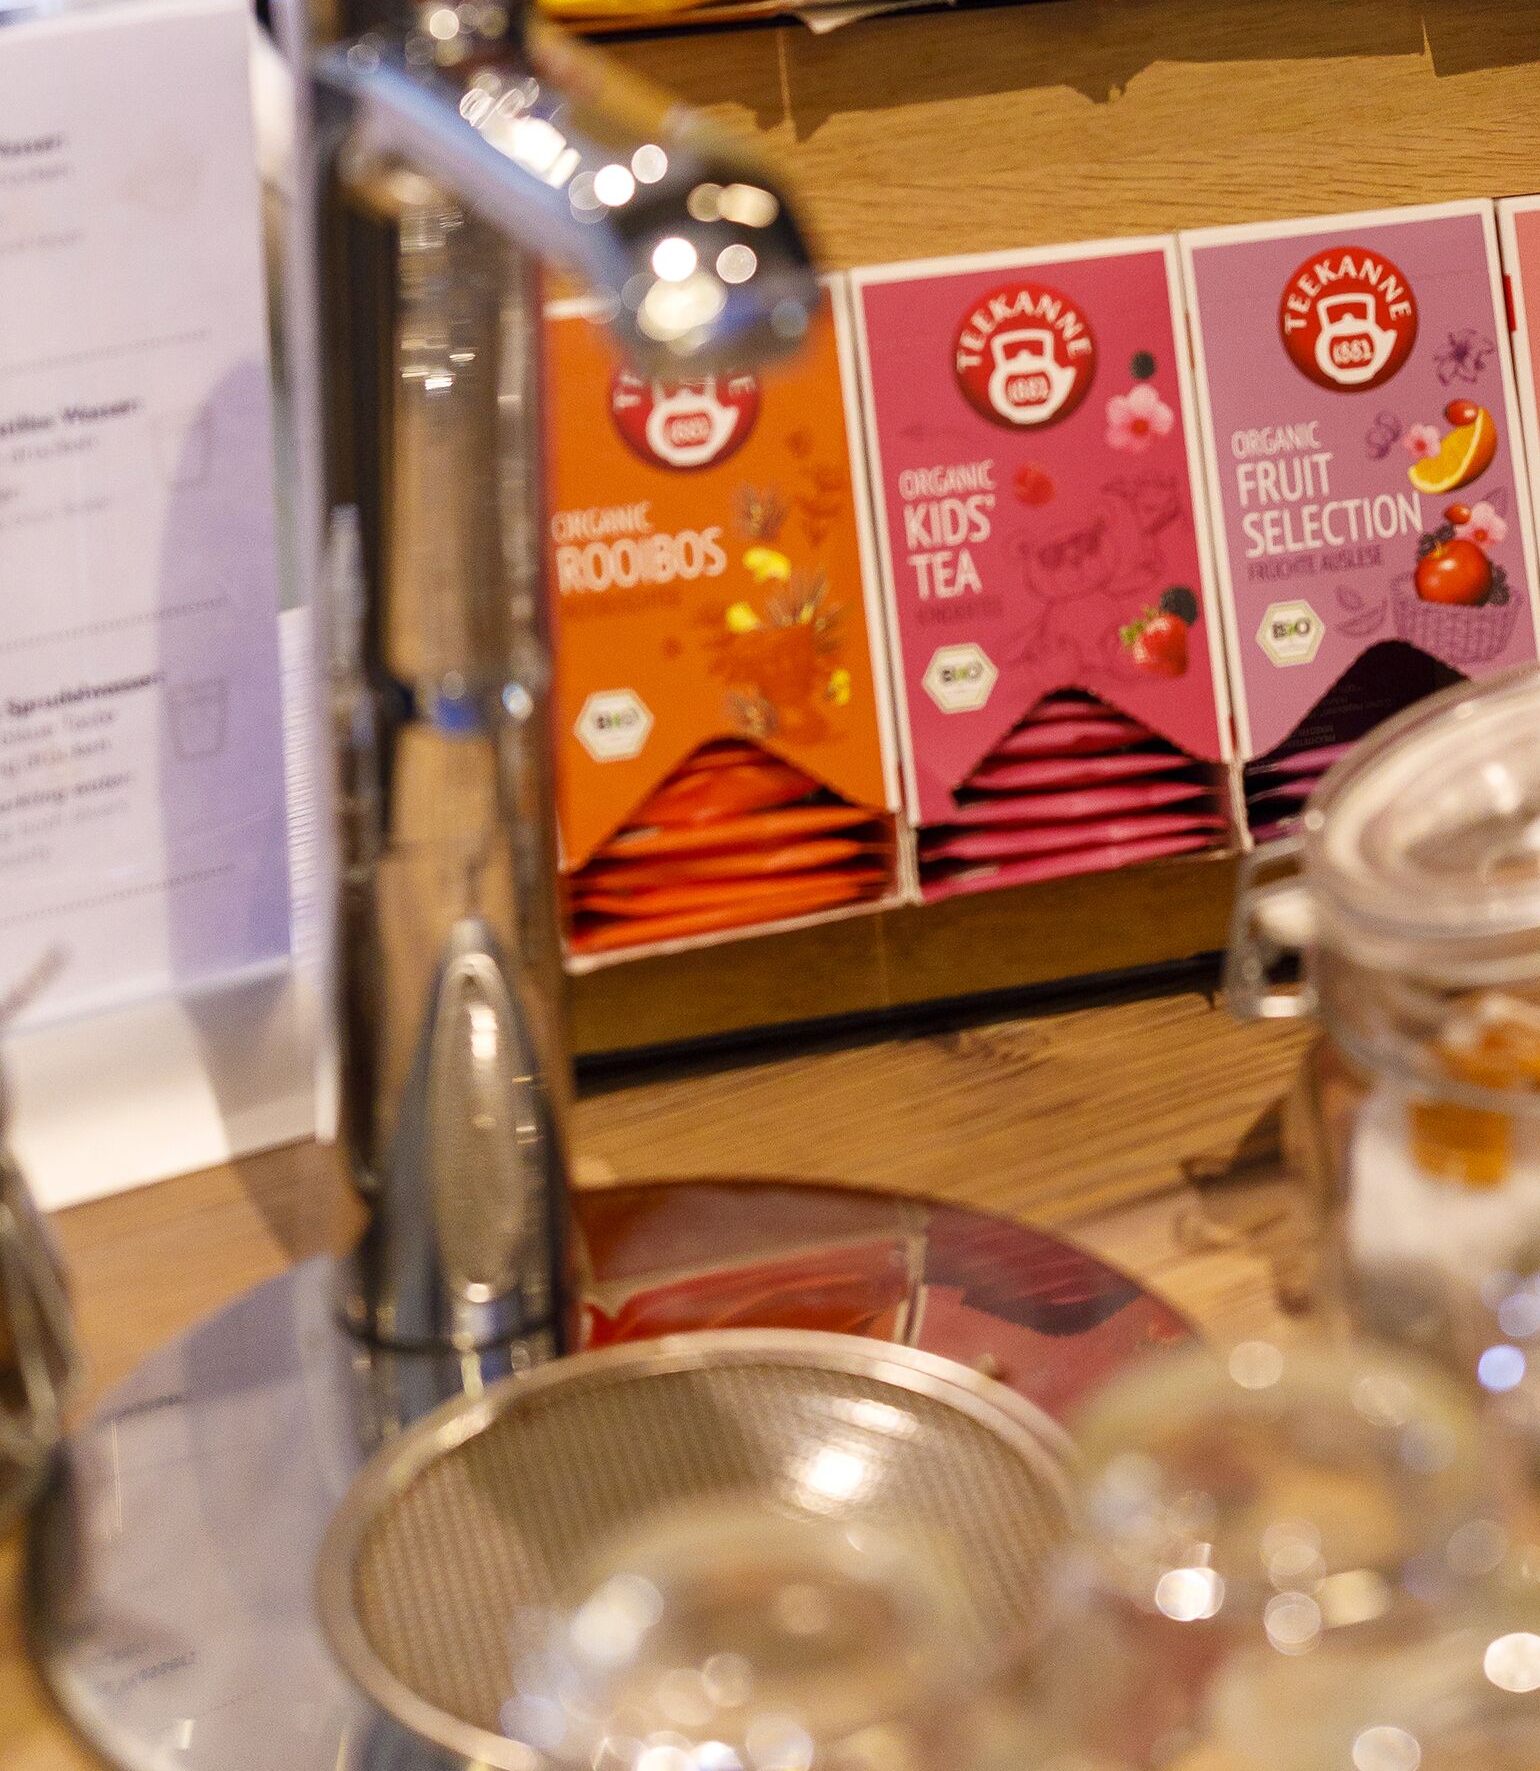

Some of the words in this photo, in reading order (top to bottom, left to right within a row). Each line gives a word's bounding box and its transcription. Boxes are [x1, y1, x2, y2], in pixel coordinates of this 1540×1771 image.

[1283, 254, 1413, 335] TEEKANNE
[955, 290, 1093, 373] TEEKANNE
[1231, 420, 1323, 460] ORGANIC
[899, 459, 997, 501] ORGANIC
[1235, 451, 1334, 508] FRUIT
[902, 493, 997, 551] KIDS'
[1242, 491, 1425, 559] SELECTION
[556, 526, 728, 596] ROOIBOS
[907, 548, 983, 601] TEA
